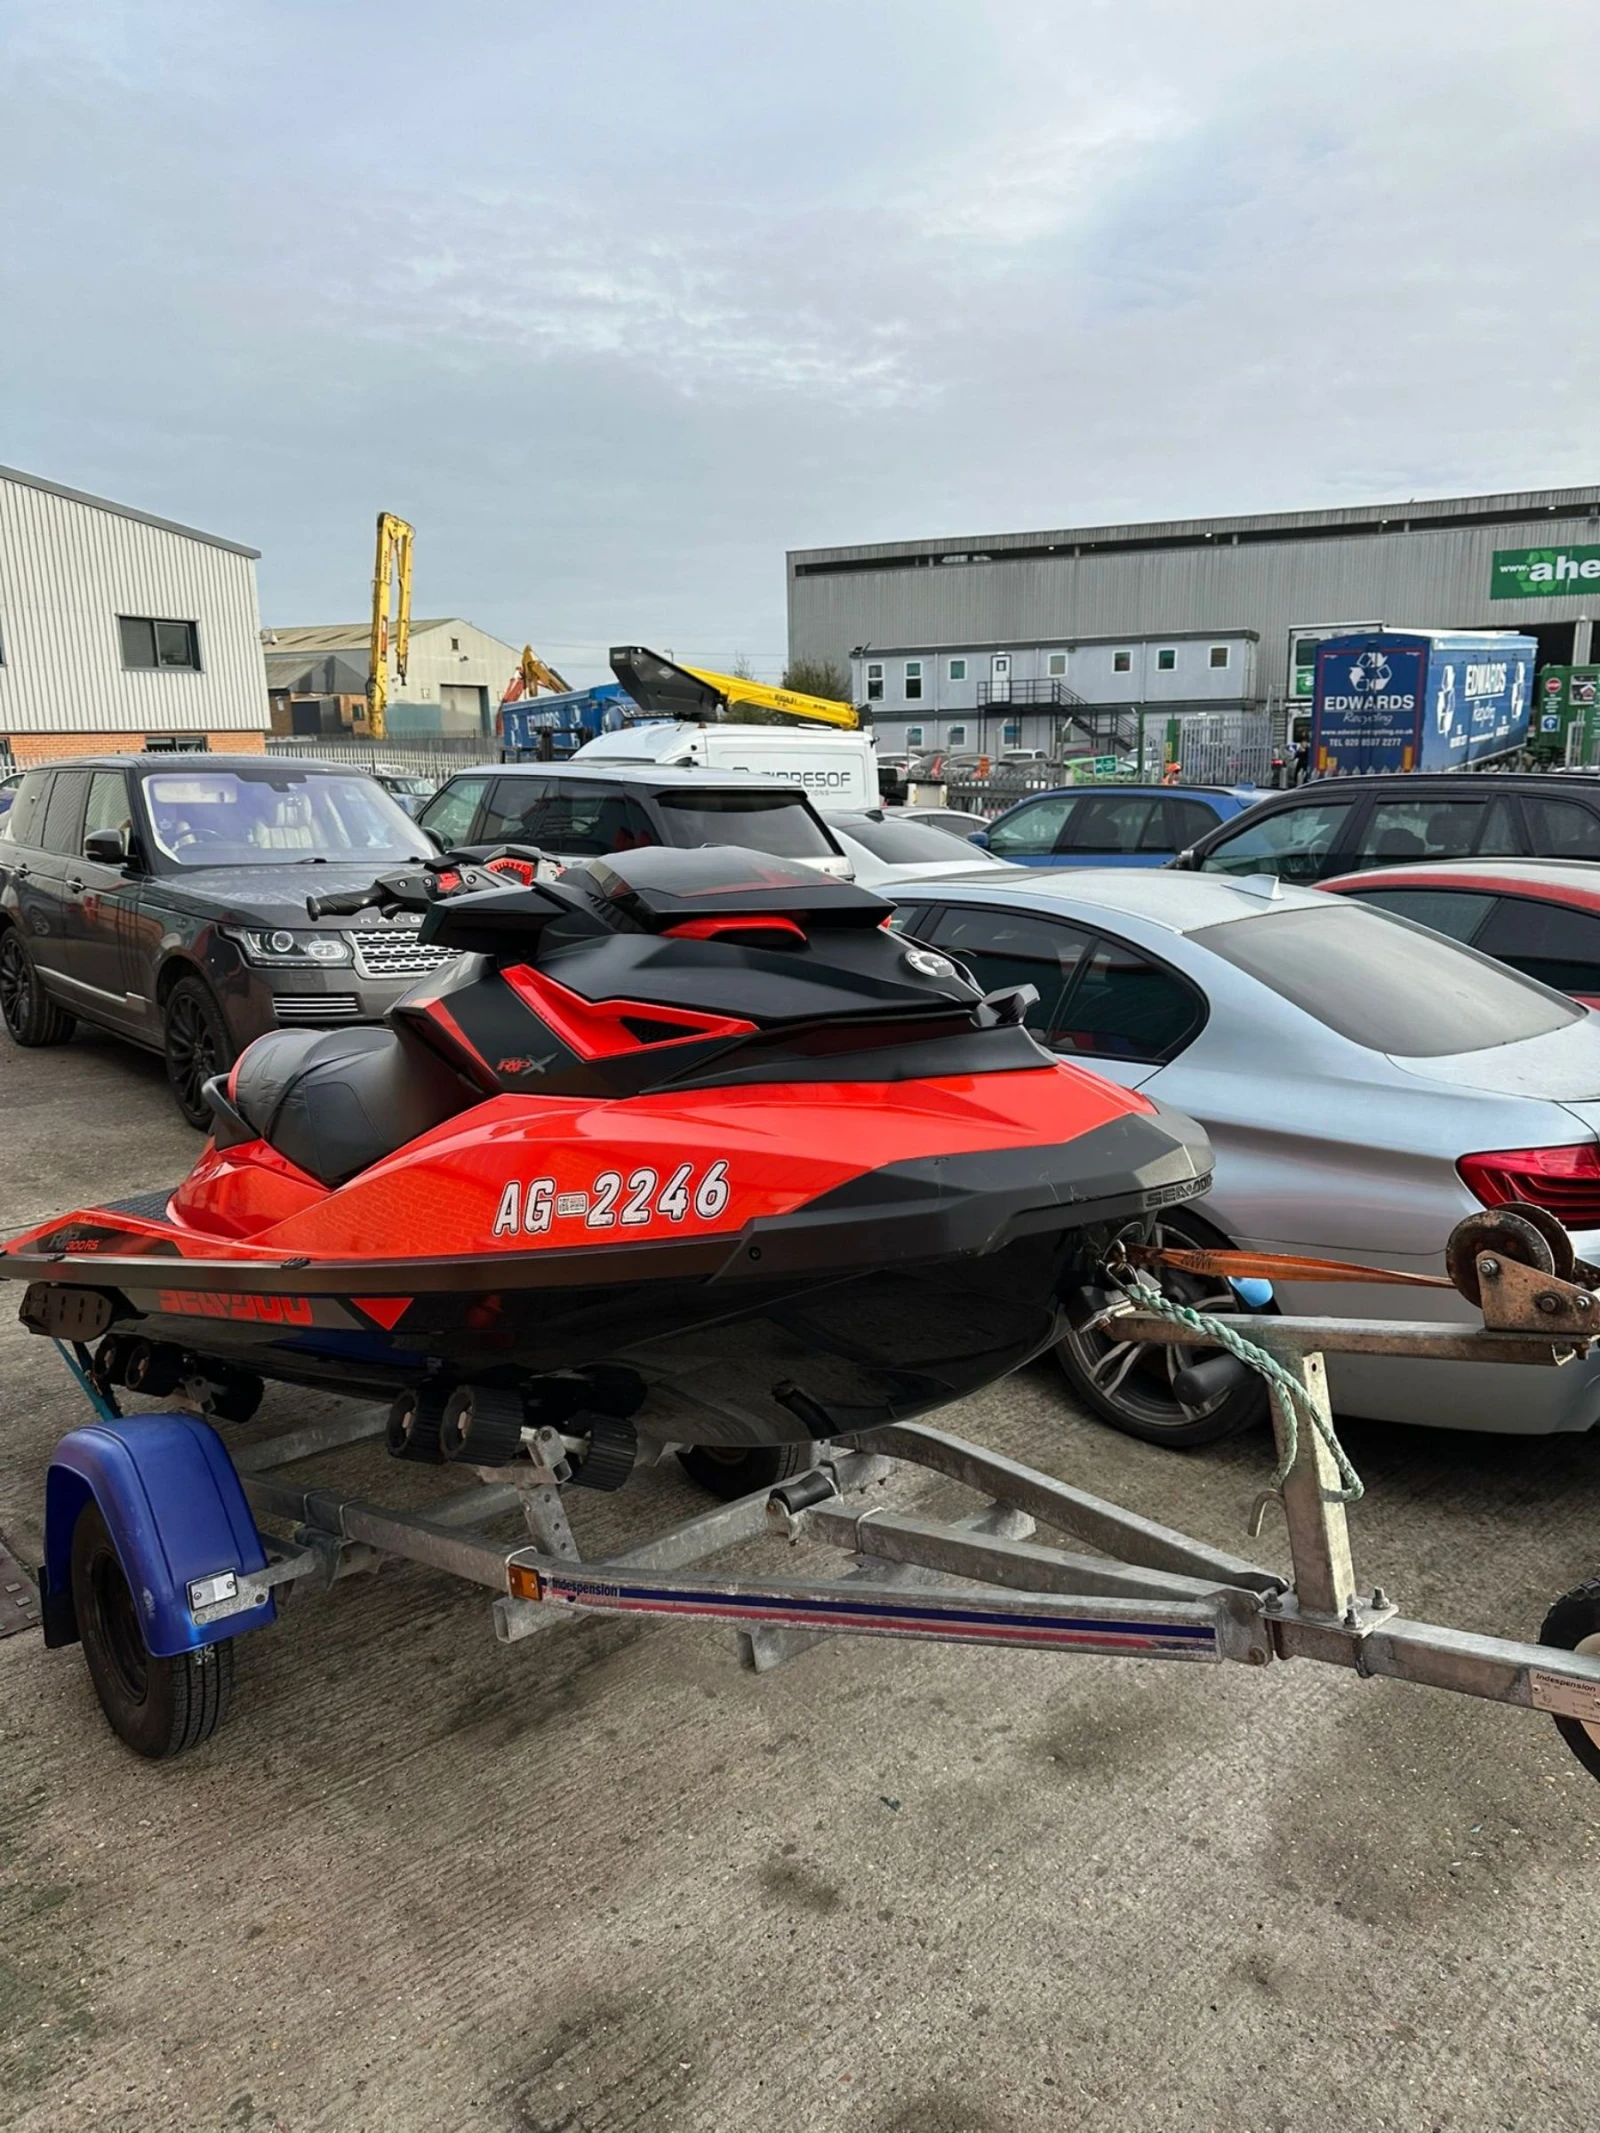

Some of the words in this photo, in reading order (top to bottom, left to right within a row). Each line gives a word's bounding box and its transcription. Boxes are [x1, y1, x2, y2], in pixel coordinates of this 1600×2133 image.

[1465, 662, 1507, 696] EDWARDS
[1324, 694, 1415, 710] EDWARDS
[1343, 710, 1394, 726] Recycling
[1535, 1673, 1597, 1692] Indespension
